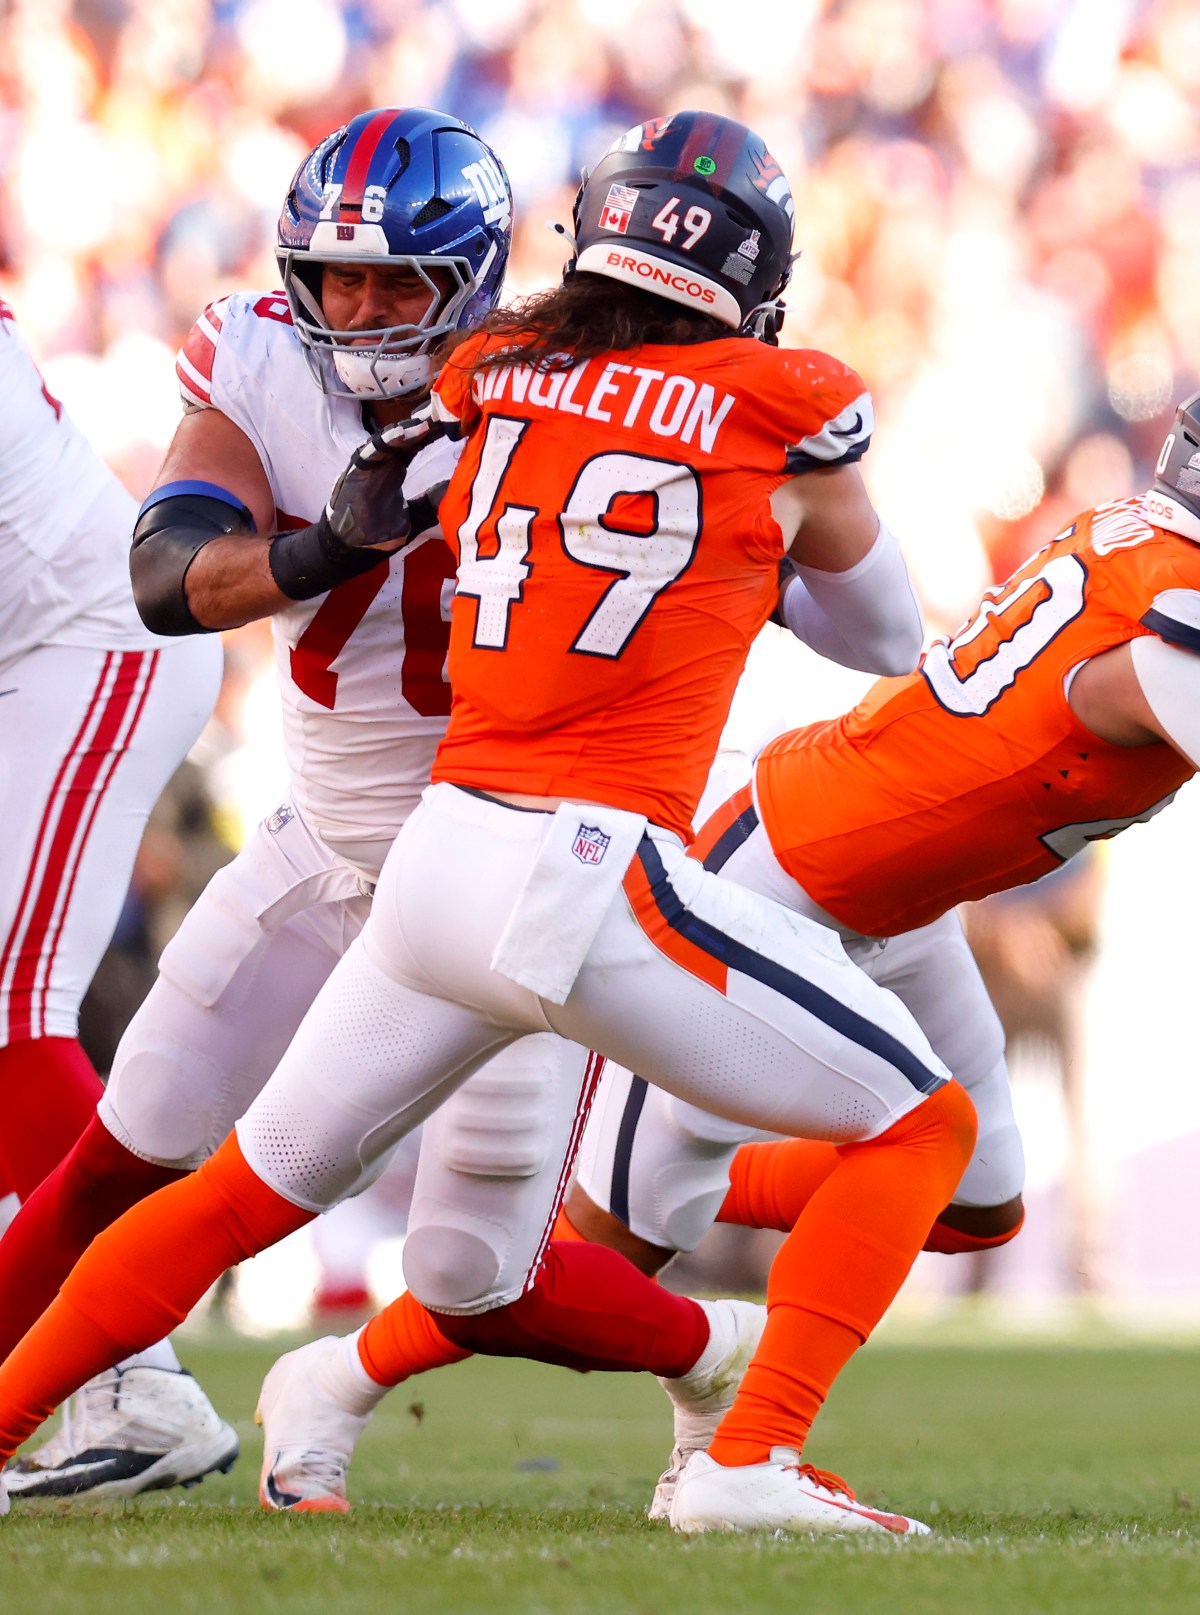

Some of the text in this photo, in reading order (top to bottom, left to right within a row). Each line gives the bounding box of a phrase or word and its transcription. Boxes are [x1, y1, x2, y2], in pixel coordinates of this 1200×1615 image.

[652, 196, 713, 251] 49
[606, 252, 717, 305] BRONCOS
[455, 412, 703, 660] 49
[574, 837, 601, 863] NFL
